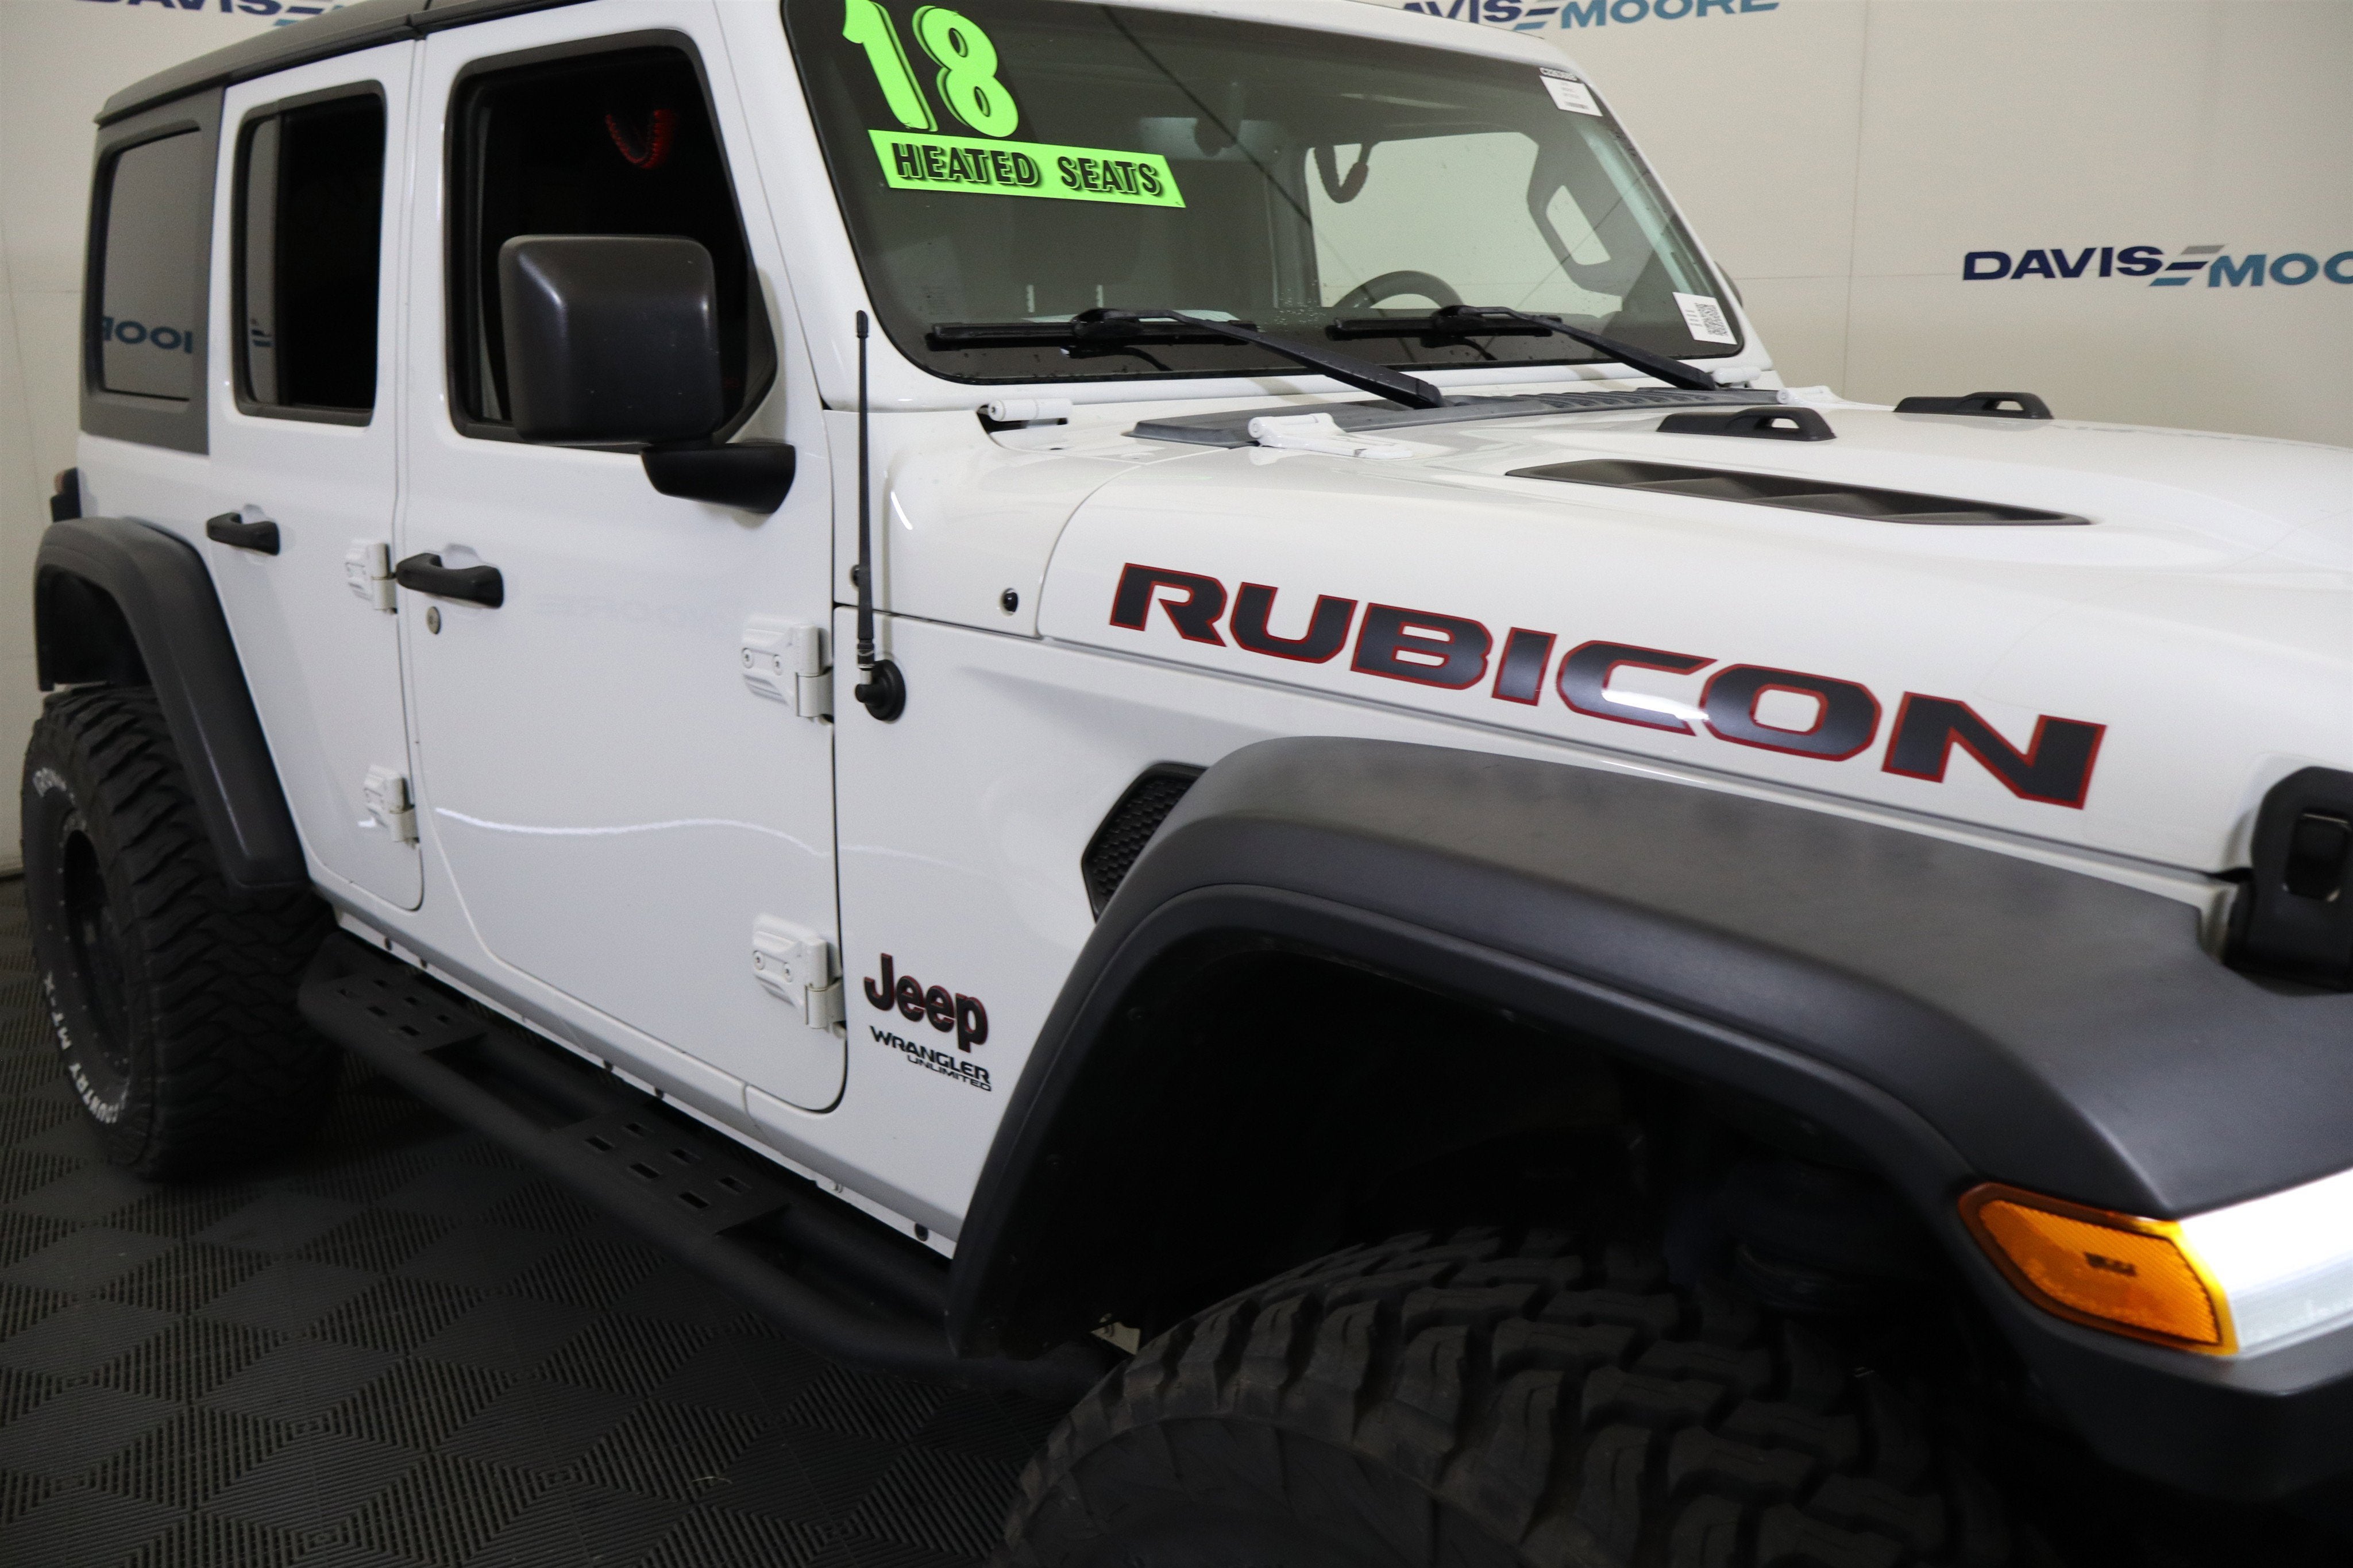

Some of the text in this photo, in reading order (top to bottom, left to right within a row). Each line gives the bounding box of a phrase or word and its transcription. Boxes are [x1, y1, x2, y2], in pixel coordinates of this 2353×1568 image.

[843, 0, 1019, 137] 18
[891, 142, 1162, 195] HEATED SEATS
[1963, 245, 2164, 280] DAVIS
[1109, 562, 2107, 809] RUBICON
[863, 952, 988, 1053] Jeep
[869, 1025, 991, 1084] WRANGLER
[907, 1055, 992, 1091] UNLIMITED
